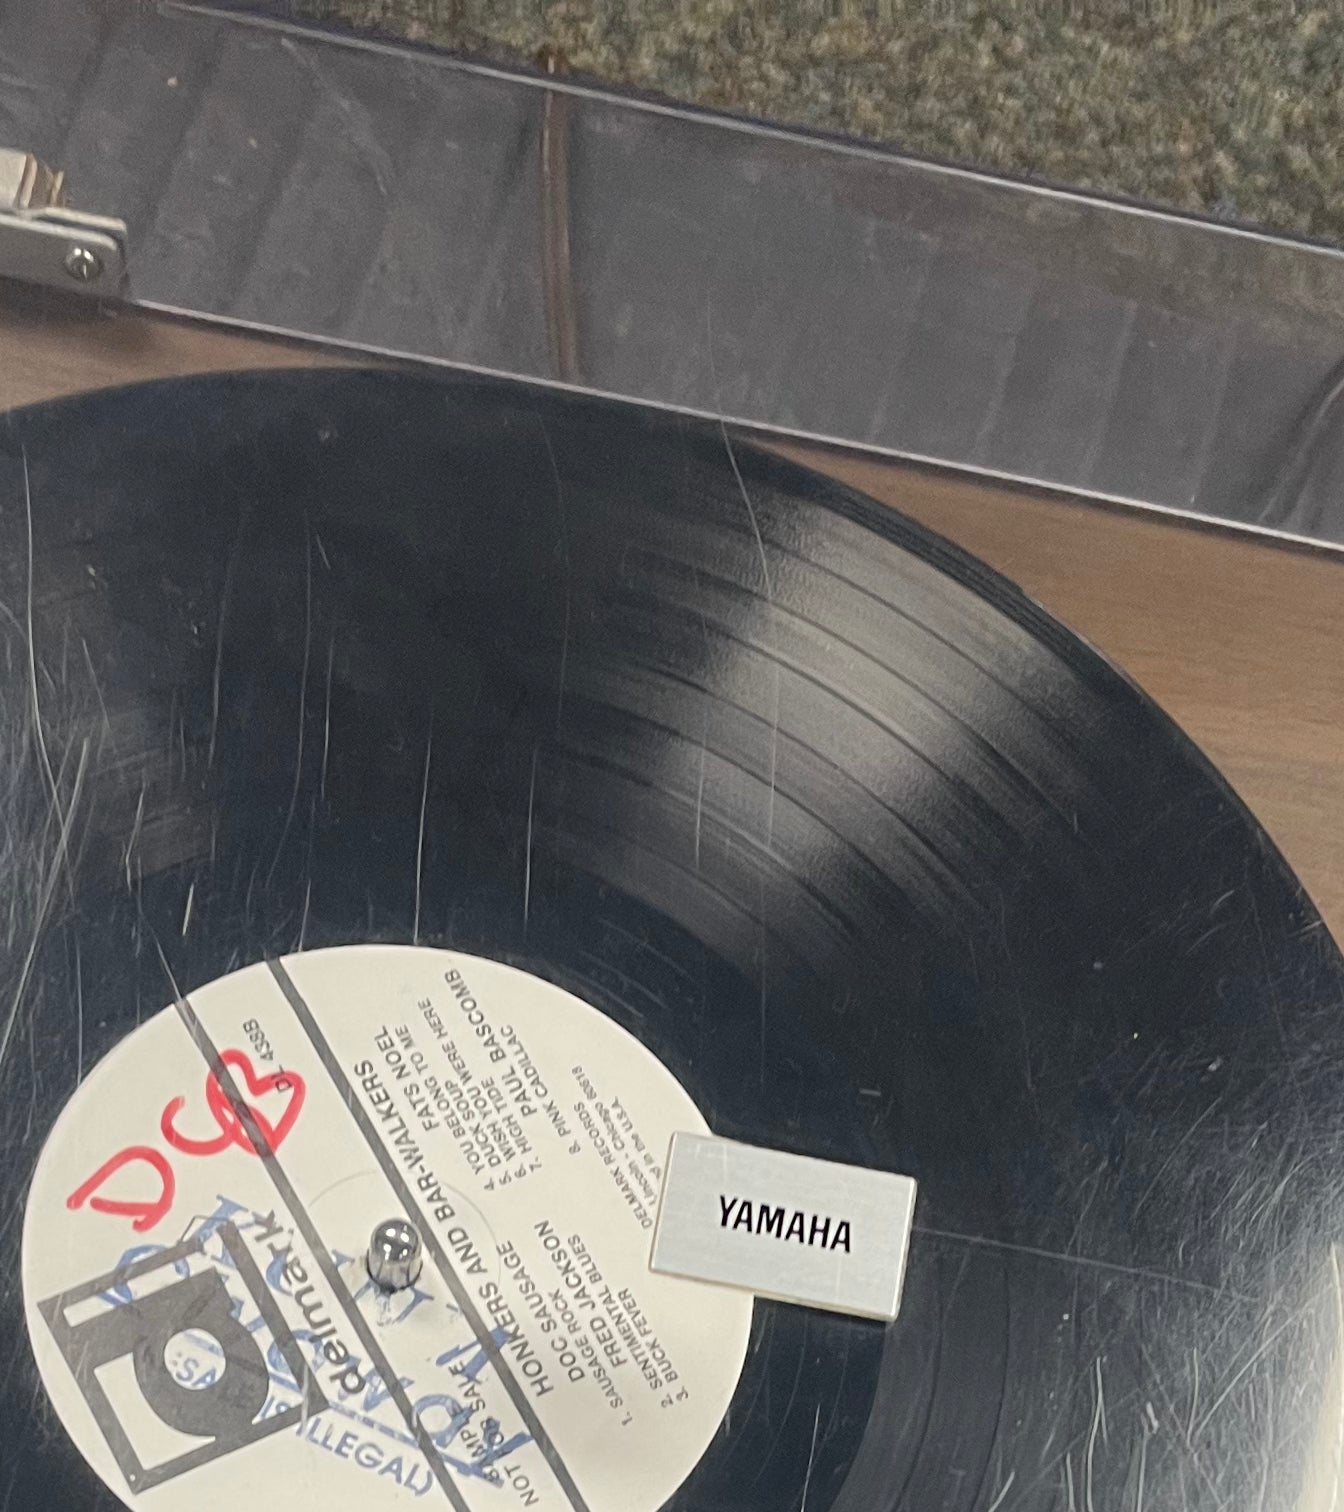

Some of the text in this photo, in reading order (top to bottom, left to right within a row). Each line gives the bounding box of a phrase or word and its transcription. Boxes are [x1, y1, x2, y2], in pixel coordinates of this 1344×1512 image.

[417, 997, 448, 1039] HERE
[444, 968, 537, 1117] PAUL BASCOMB
[266, 1063, 294, 1094] DL
[374, 1025, 439, 1131] FATS NOEL
[441, 1039, 472, 1085] WERE
[500, 1024, 548, 1098] CADILLAC
[394, 1024, 494, 1190] 4. YOU BELONG TO ME
[444, 1079, 475, 1121] SOUP
[466, 1085, 492, 1120] YOU
[480, 1076, 542, 1172] 7. HIGH TIDE
[542, 1099, 571, 1137] PINK
[594, 1101, 625, 1151] Chicago
[468, 1122, 501, 1167] DUCK
[486, 1120, 516, 1162] WISH
[573, 1101, 652, 1229] DELMARK RECORDS
[353, 1059, 556, 1398] HONKERS AND BAR-WALKERS
[719, 1195, 851, 1253] YAMAHA
[251, 1209, 367, 1395] delmark
[495, 1240, 585, 1382] DOC SAUSAGE
[533, 1219, 627, 1368] FRED JACKSON
[567, 1233, 673, 1408] 2. SENTIMENTAL BLUES
[547, 1287, 632, 1426] 1. SAUSAGE ROCK
[617, 1287, 688, 1401] 3. BUCK FEVER
[445, 1358, 488, 1415] SALE
[503, 1464, 539, 1506] NOT
